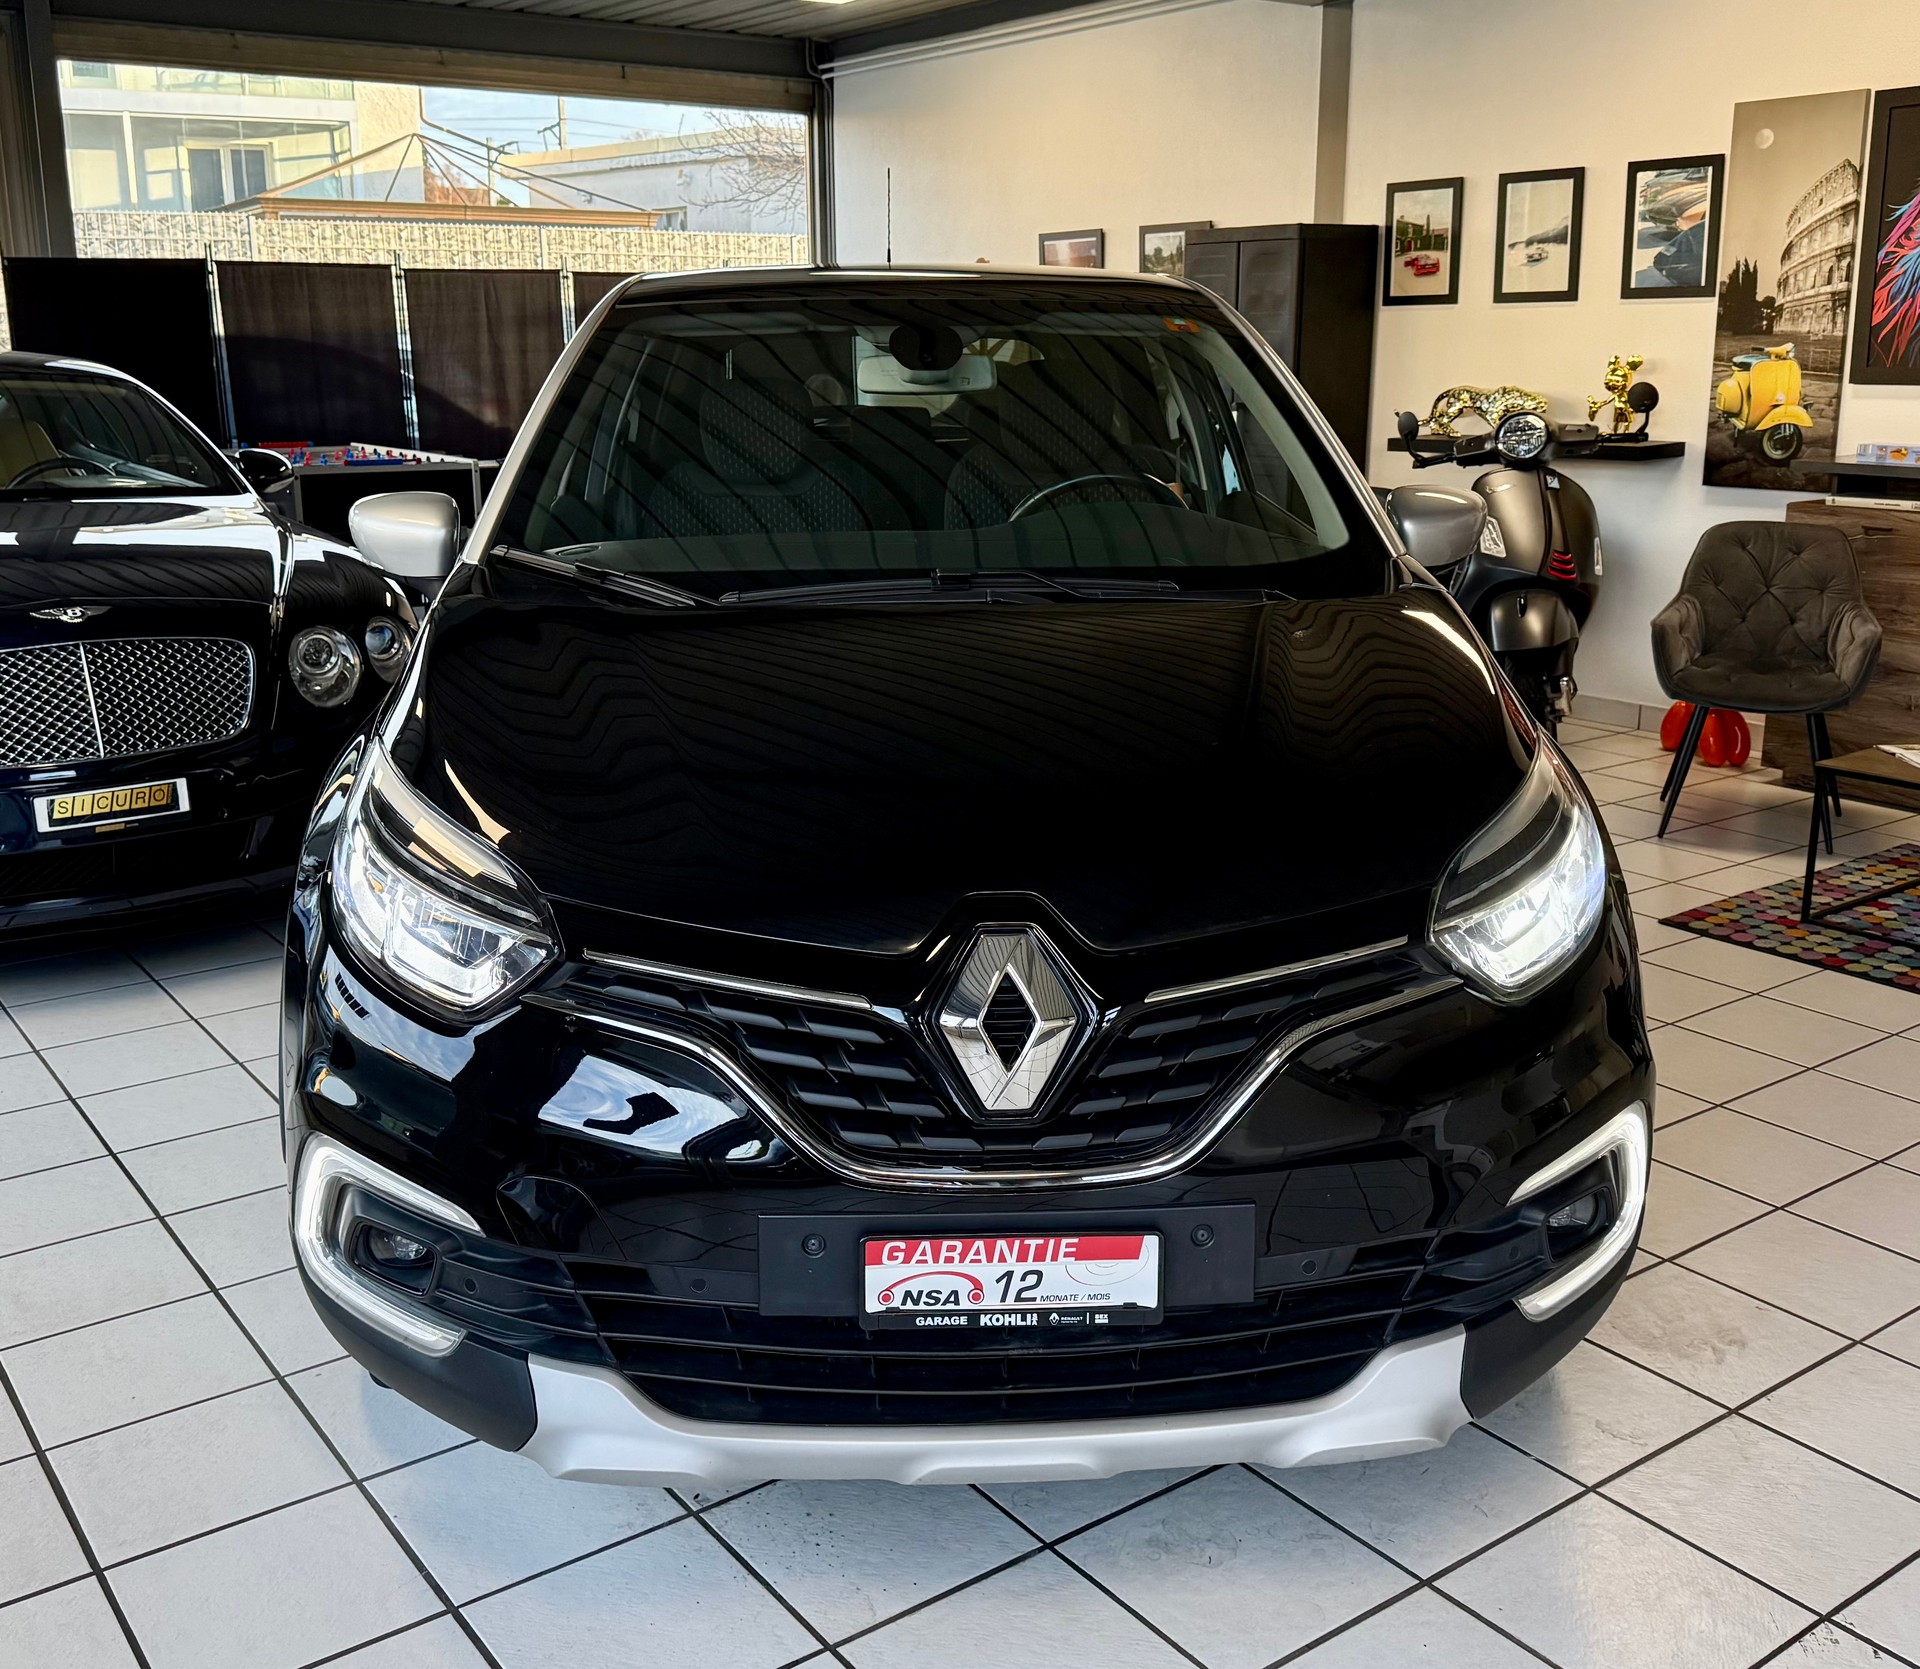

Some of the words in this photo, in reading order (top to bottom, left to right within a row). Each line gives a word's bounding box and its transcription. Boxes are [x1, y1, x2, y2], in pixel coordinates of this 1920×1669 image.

[57, 787, 166, 815] SICURO
[881, 1238, 1080, 1266] GARANTIE
[900, 1289, 961, 1307] NSA
[995, 1269, 1044, 1304] 12
[1040, 1293, 1079, 1303] MONATE
[1087, 1292, 1111, 1301] MOIS
[915, 1315, 968, 1326] GARAGE
[980, 1313, 1031, 1327] KOHLI
